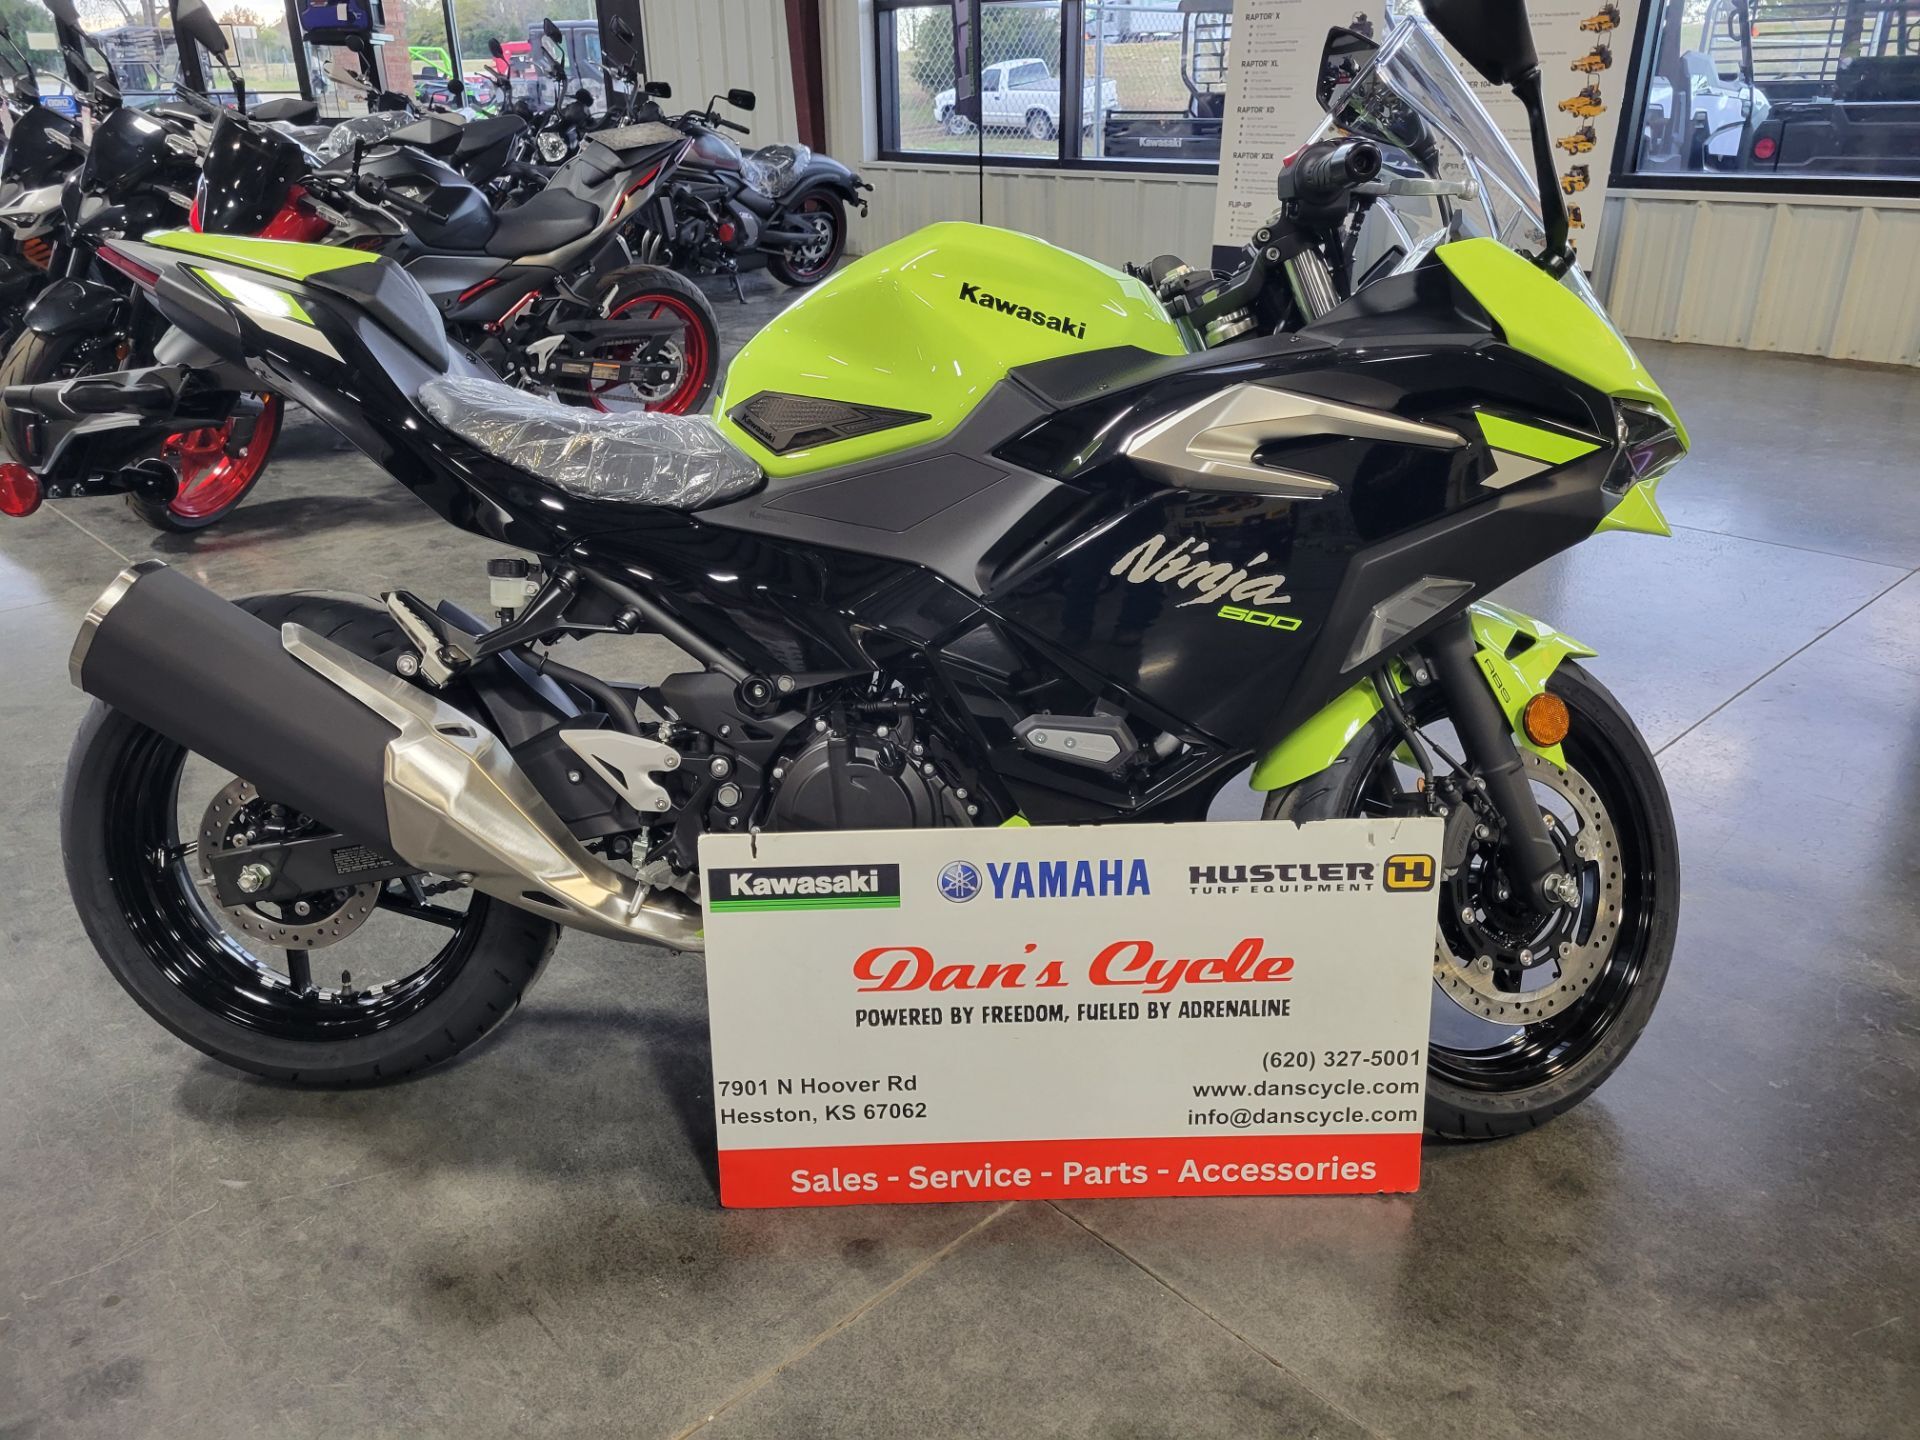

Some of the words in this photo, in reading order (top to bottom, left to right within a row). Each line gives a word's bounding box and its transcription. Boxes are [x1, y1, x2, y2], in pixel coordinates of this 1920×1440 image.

[1275, 12, 1281, 20] X
[1139, 137, 1182, 147] Kawasaki
[959, 281, 1087, 340] Kawasaki
[741, 413, 776, 443] Kawasaki
[1110, 534, 1291, 608] Ninja
[1217, 605, 1302, 631] 500
[1484, 658, 1511, 703] ABS
[729, 869, 879, 896] Kawasaki
[986, 858, 1151, 899] YAMAHA
[1189, 862, 1375, 884] HUSTLER
[1190, 886, 1241, 895] TURF
[1250, 883, 1374, 894] EQUIPMENT
[852, 943, 1069, 993] Dan's
[1088, 937, 1295, 995] Cycle
[855, 1006, 943, 1028] POWERED
[950, 1006, 974, 1026] BY
[982, 1003, 1070, 1025] FREEDOM,
[1076, 1001, 1141, 1022] FUELED
[1146, 1001, 1172, 1020] BY
[1177, 998, 1292, 1019] ADRENALINE
[1262, 1051, 1316, 1072] (620)
[1323, 1049, 1420, 1067] 327-5001
[718, 1079, 768, 1097] 7901
[778, 1078, 792, 1095] N
[801, 1077, 881, 1094] Hoover
[887, 1074, 917, 1091] Rd
[1193, 1079, 1419, 1099] www.danscycle.com
[721, 1106, 817, 1124] Hesston,
[826, 1104, 856, 1121] KS
[864, 1102, 927, 1119] 67062
[1188, 1107, 1418, 1128] info@danscycle.com
[791, 1167, 879, 1193] Sales
[908, 1162, 1031, 1190] Service
[1063, 1161, 1149, 1186] Parts
[1177, 1155, 1377, 1183] Accessories
